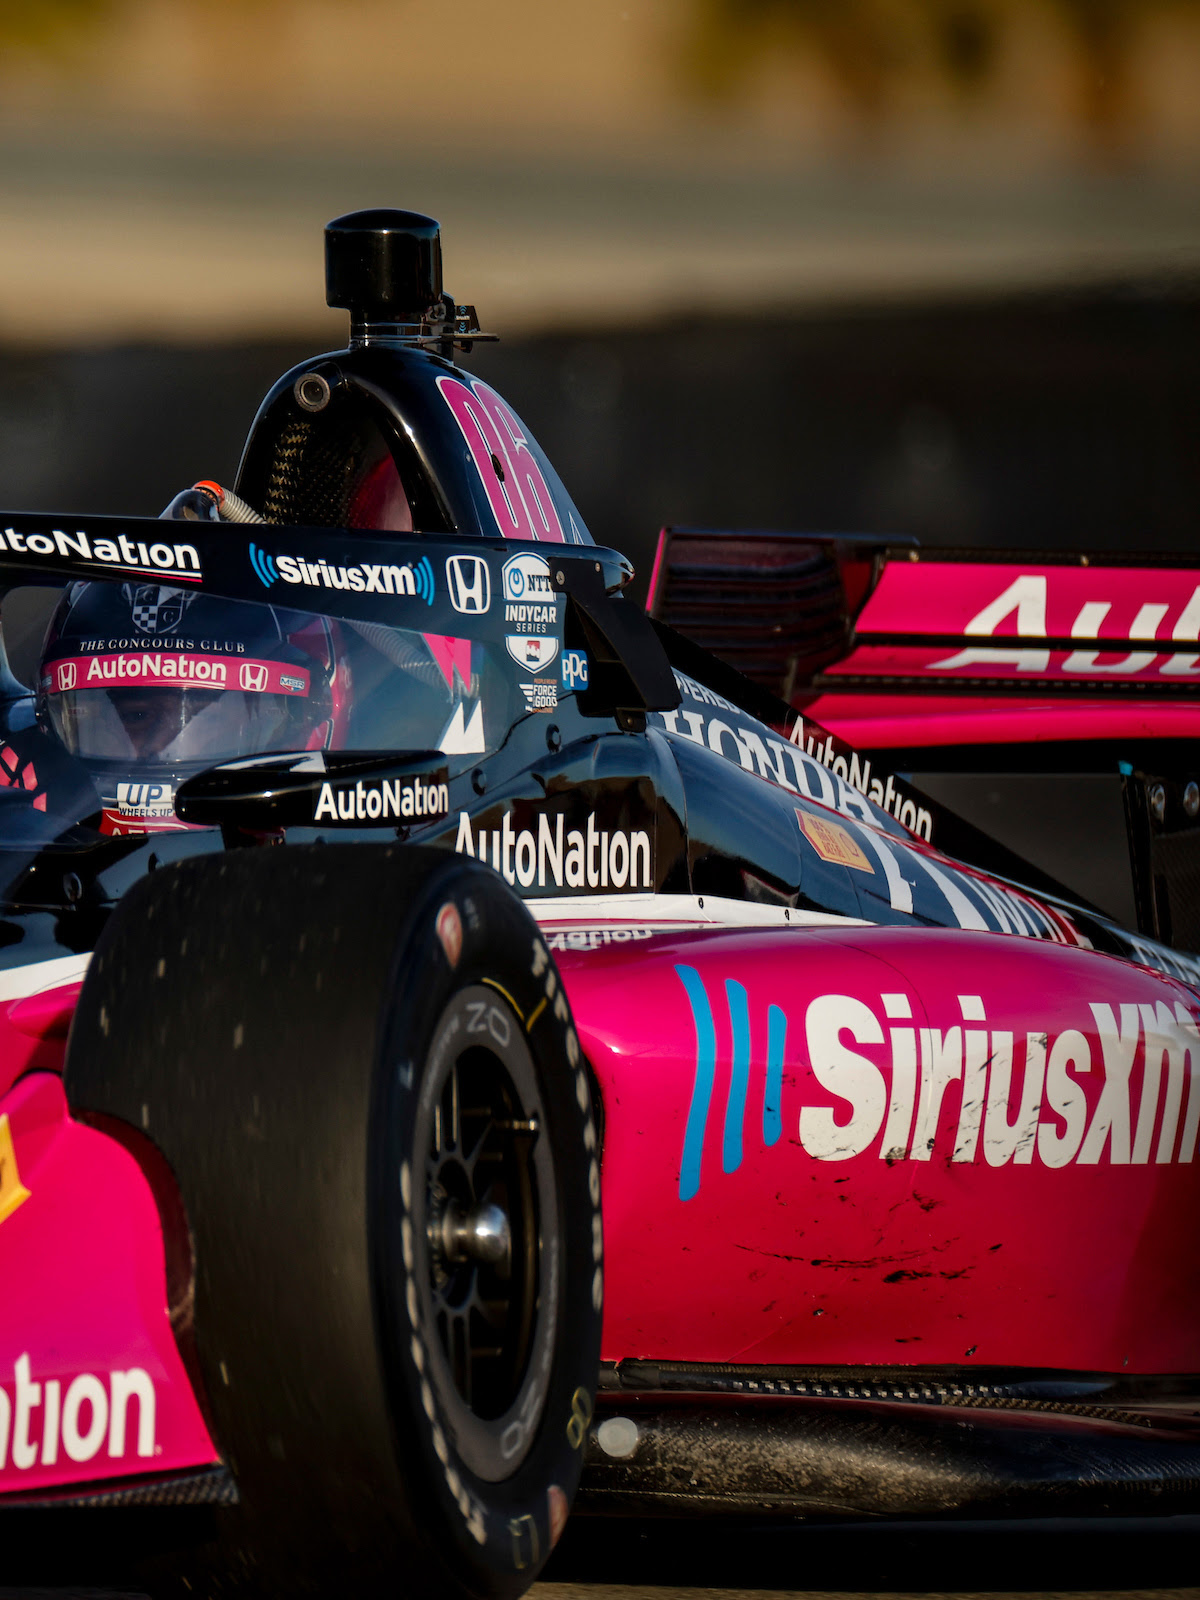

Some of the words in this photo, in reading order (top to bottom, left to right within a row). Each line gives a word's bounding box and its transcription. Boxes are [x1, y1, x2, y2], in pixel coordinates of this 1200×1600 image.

[505, 604, 557, 623] INDYCAR
[516, 623, 547, 633] SERIES
[79, 640, 104, 652] THE
[108, 638, 194, 650] CONCOURS
[200, 640, 245, 653] CLUB
[87, 655, 226, 681] AutoNation
[562, 653, 588, 687] PPG
[534, 685, 557, 696] FORCE
[660, 709, 886, 830] HONDA
[789, 715, 933, 843] AutoNation
[126, 785, 162, 807] UP
[314, 777, 449, 820] AutoNation
[120, 807, 157, 817] WHEELS
[160, 809, 173, 817] UP
[455, 810, 650, 888] AutoNation
